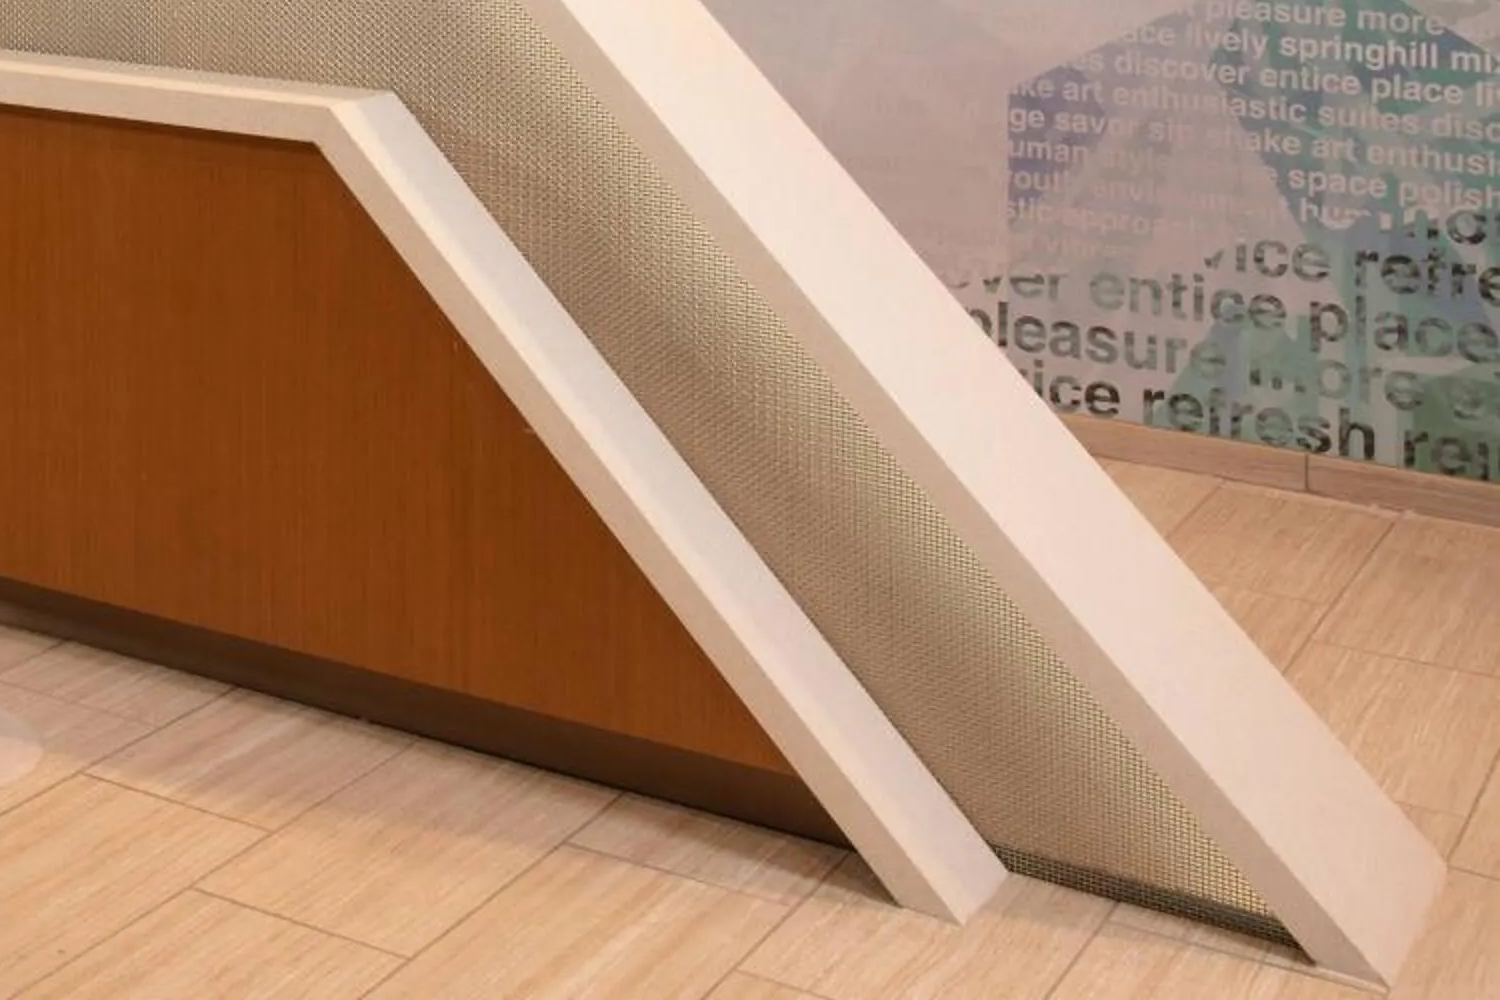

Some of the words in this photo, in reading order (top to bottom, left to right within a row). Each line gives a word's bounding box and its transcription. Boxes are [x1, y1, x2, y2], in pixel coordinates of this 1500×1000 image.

[1357, 9, 1446, 36] more
[1280, 34, 1439, 71] springhill
[1114, 50, 1251, 85] discover
[1260, 66, 1362, 96] entice
[1372, 74, 1464, 105] place
[1062, 80, 1104, 104] art
[1112, 84, 1308, 123] enthusiastic
[1319, 101, 1421, 136] suites
[1312, 136, 1358, 163] art
[1288, 168, 1389, 198] space
[1089, 271, 1287, 330] entice
[1310, 295, 1499, 364] place
[1021, 359, 1121, 419] ice
[1142, 386, 1375, 461] refresh
